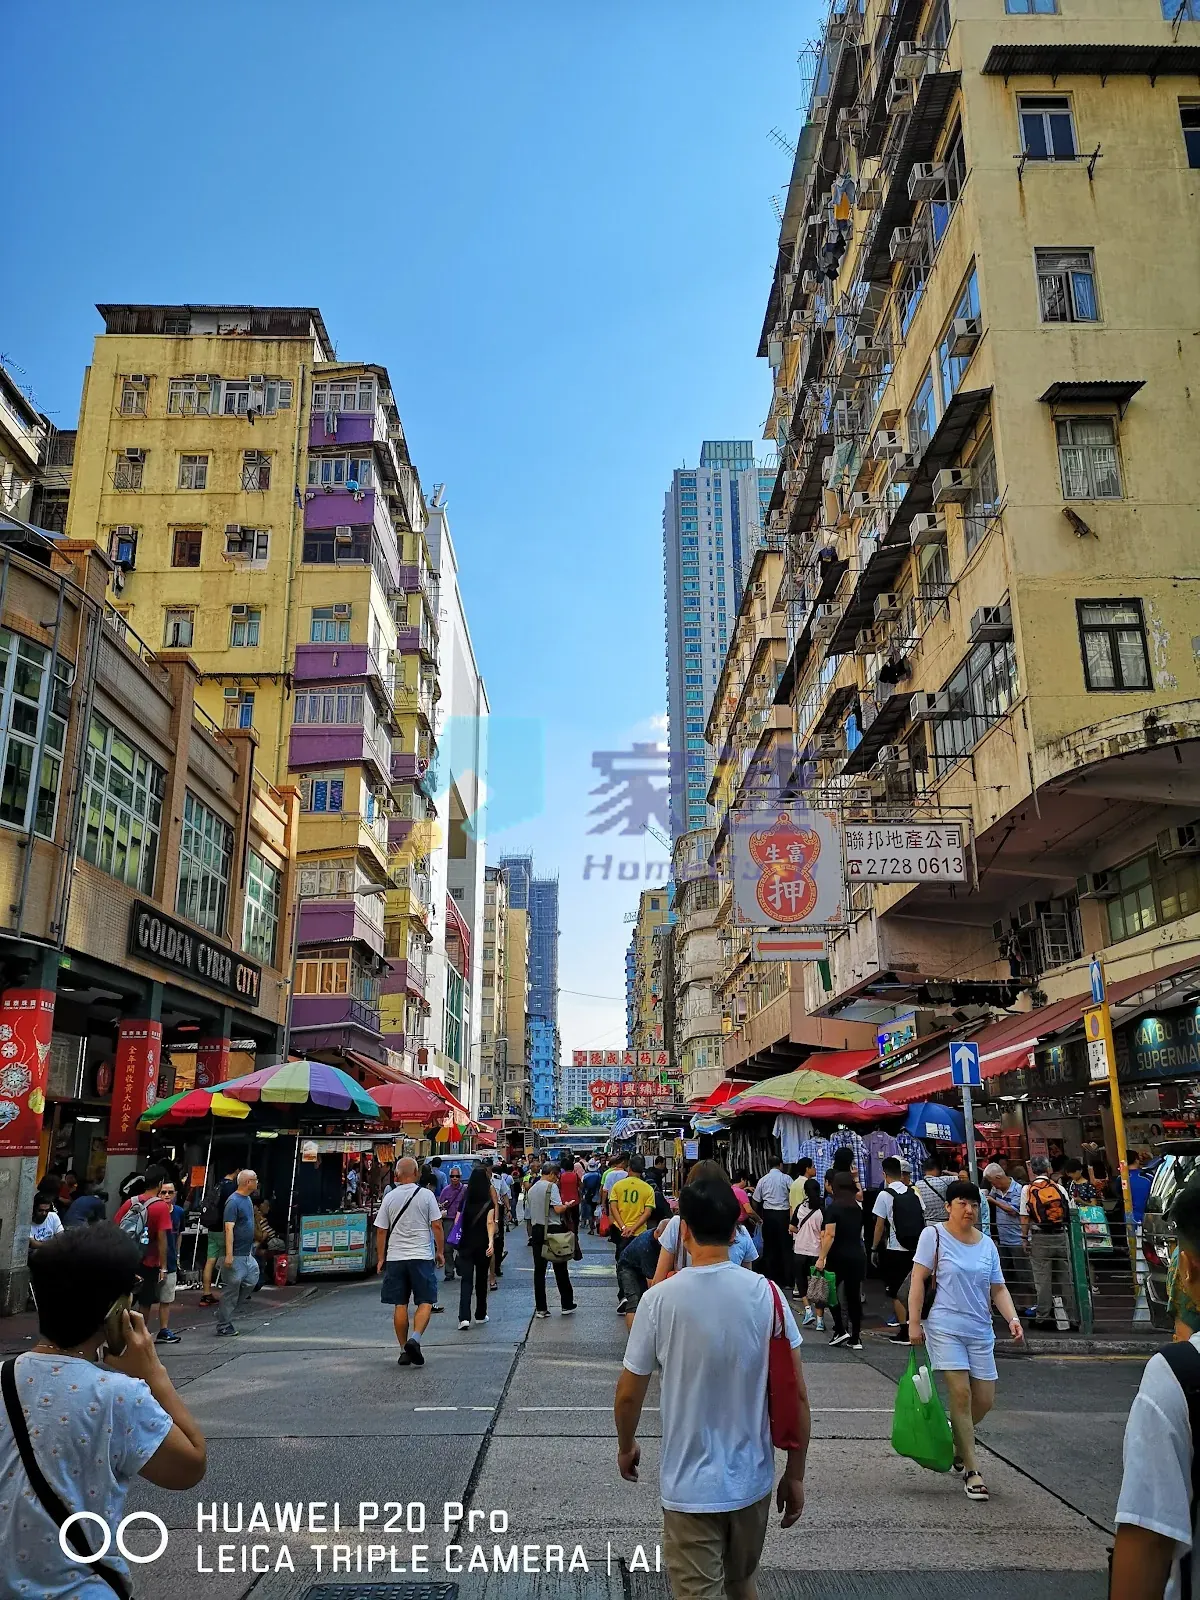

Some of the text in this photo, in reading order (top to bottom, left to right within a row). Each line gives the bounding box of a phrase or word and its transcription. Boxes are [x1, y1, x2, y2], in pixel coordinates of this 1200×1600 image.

[846, 830, 961, 850] 聯邦地產公司
[867, 857, 963, 875] 2728 0613
[767, 874, 806, 913] 押
[139, 913, 259, 998] GOLDEN CYBER CITY
[1134, 1025, 1153, 1048] KAI
[1155, 1022, 1173, 1042] BO
[623, 1189, 639, 1203] 10
